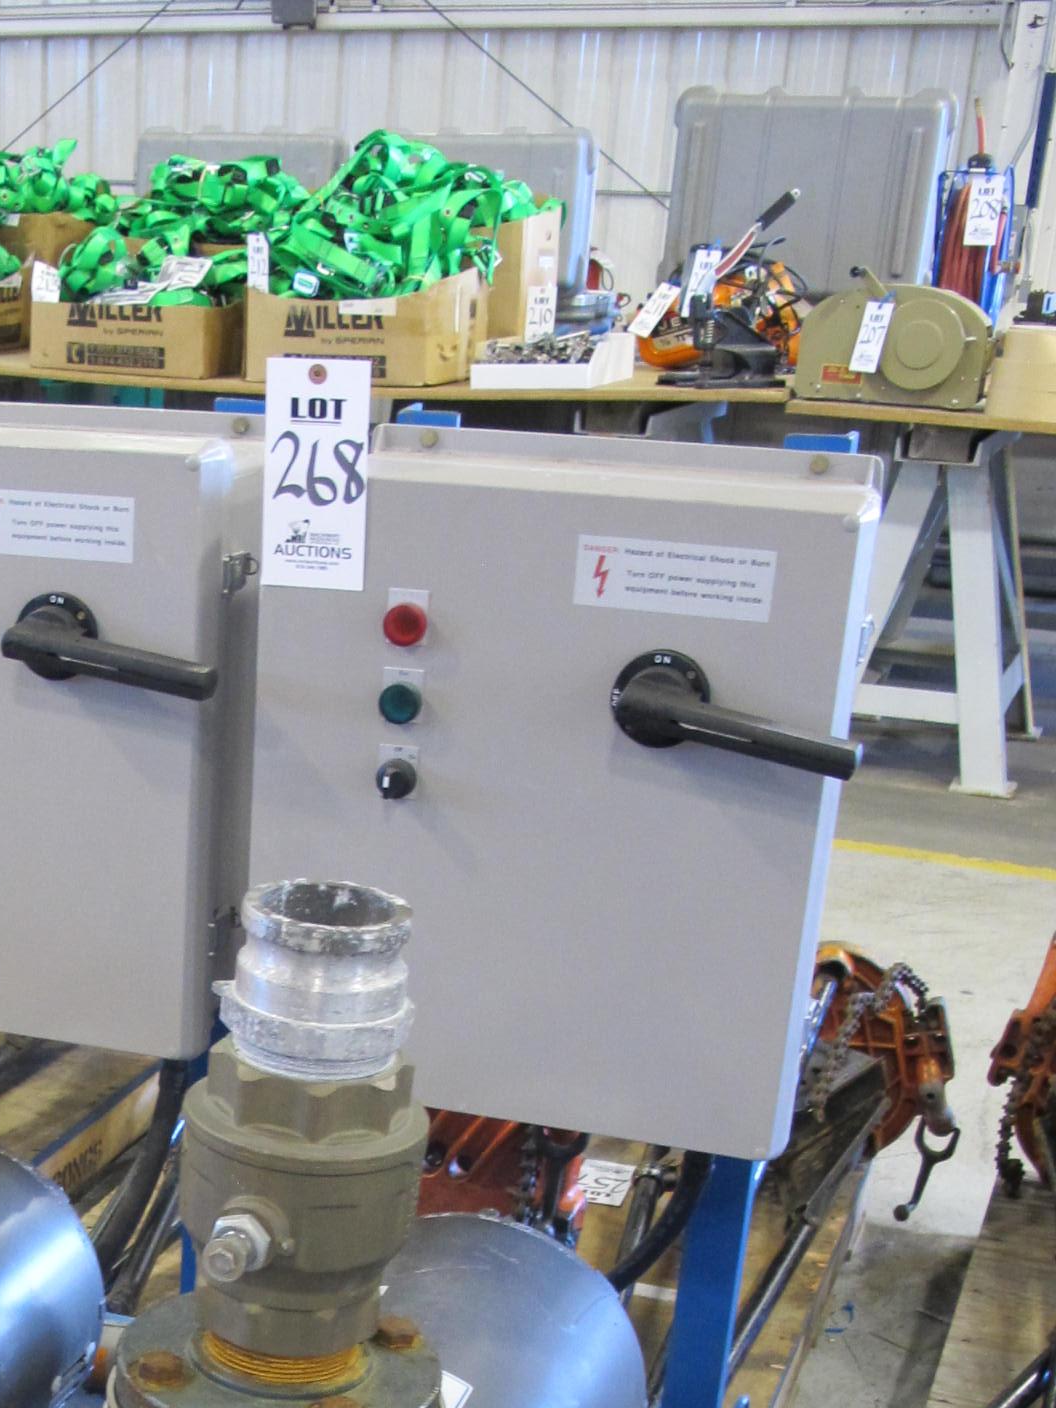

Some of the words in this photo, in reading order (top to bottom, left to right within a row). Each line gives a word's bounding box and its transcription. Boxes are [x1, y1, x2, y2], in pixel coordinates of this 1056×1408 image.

[66, 303, 163, 328] MILLER
[284, 305, 384, 337] MILLER
[290, 397, 347, 420] LOT
[271, 430, 364, 507] 268
[273, 544, 352, 560] AUCTIONS
[667, 551, 706, 562] Electrical
[710, 555, 735, 564] Shock
[751, 559, 770, 568] Burn
[627, 569, 645, 578] Turn
[668, 574, 692, 582] power
[696, 578, 737, 589] supplying
[49, 594, 64, 605] ON
[625, 586, 668, 595] equipment
[670, 590, 697, 598] before
[700, 593, 733, 603] working
[654, 655, 671, 664] ON
